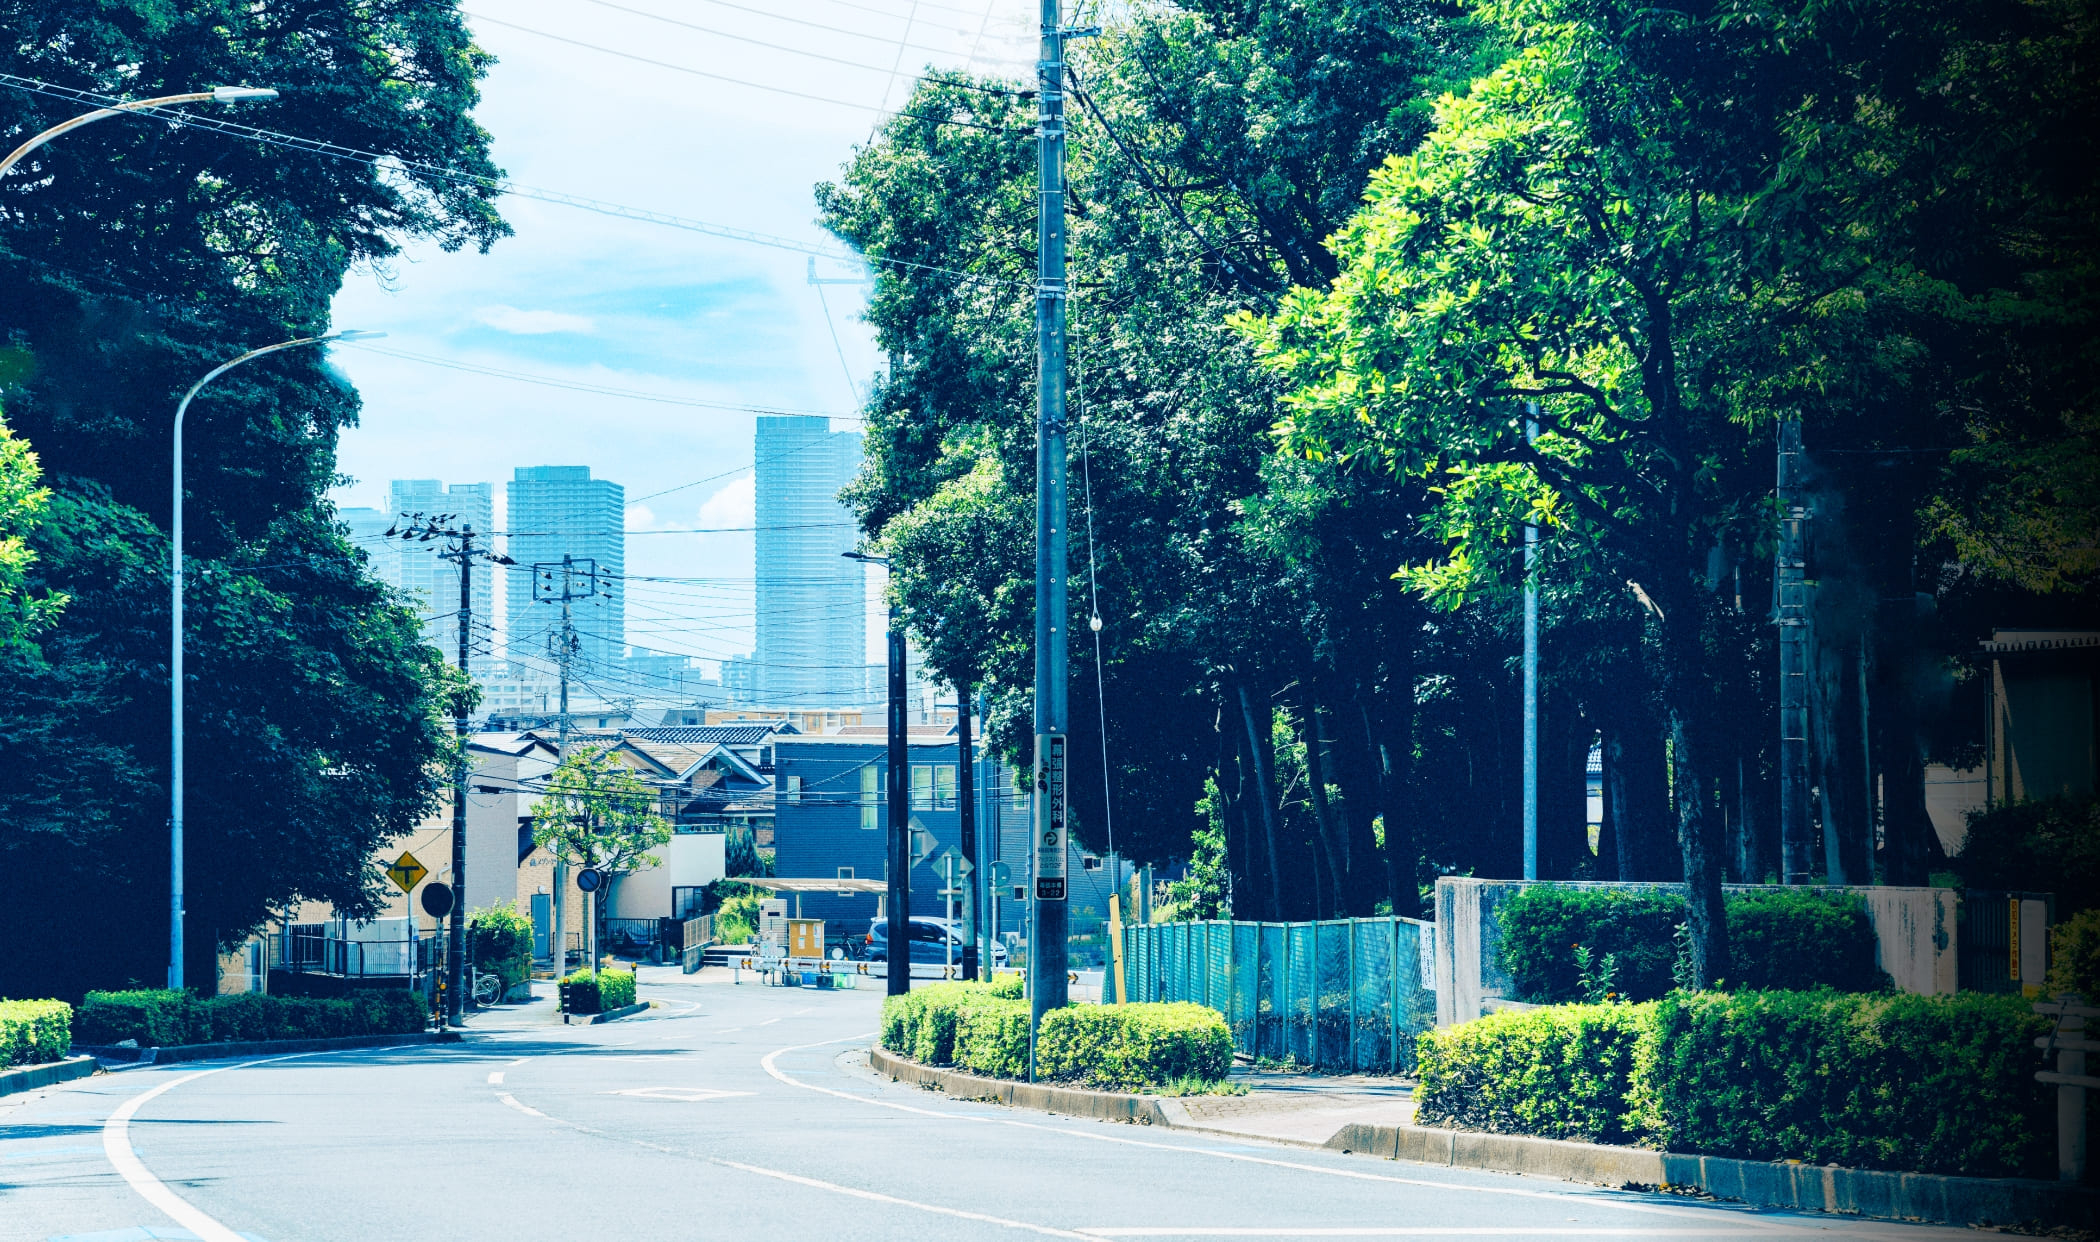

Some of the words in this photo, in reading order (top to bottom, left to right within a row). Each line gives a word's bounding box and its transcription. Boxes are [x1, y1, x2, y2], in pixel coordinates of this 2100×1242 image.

[1051, 744, 1063, 823] 幕張整形外科
